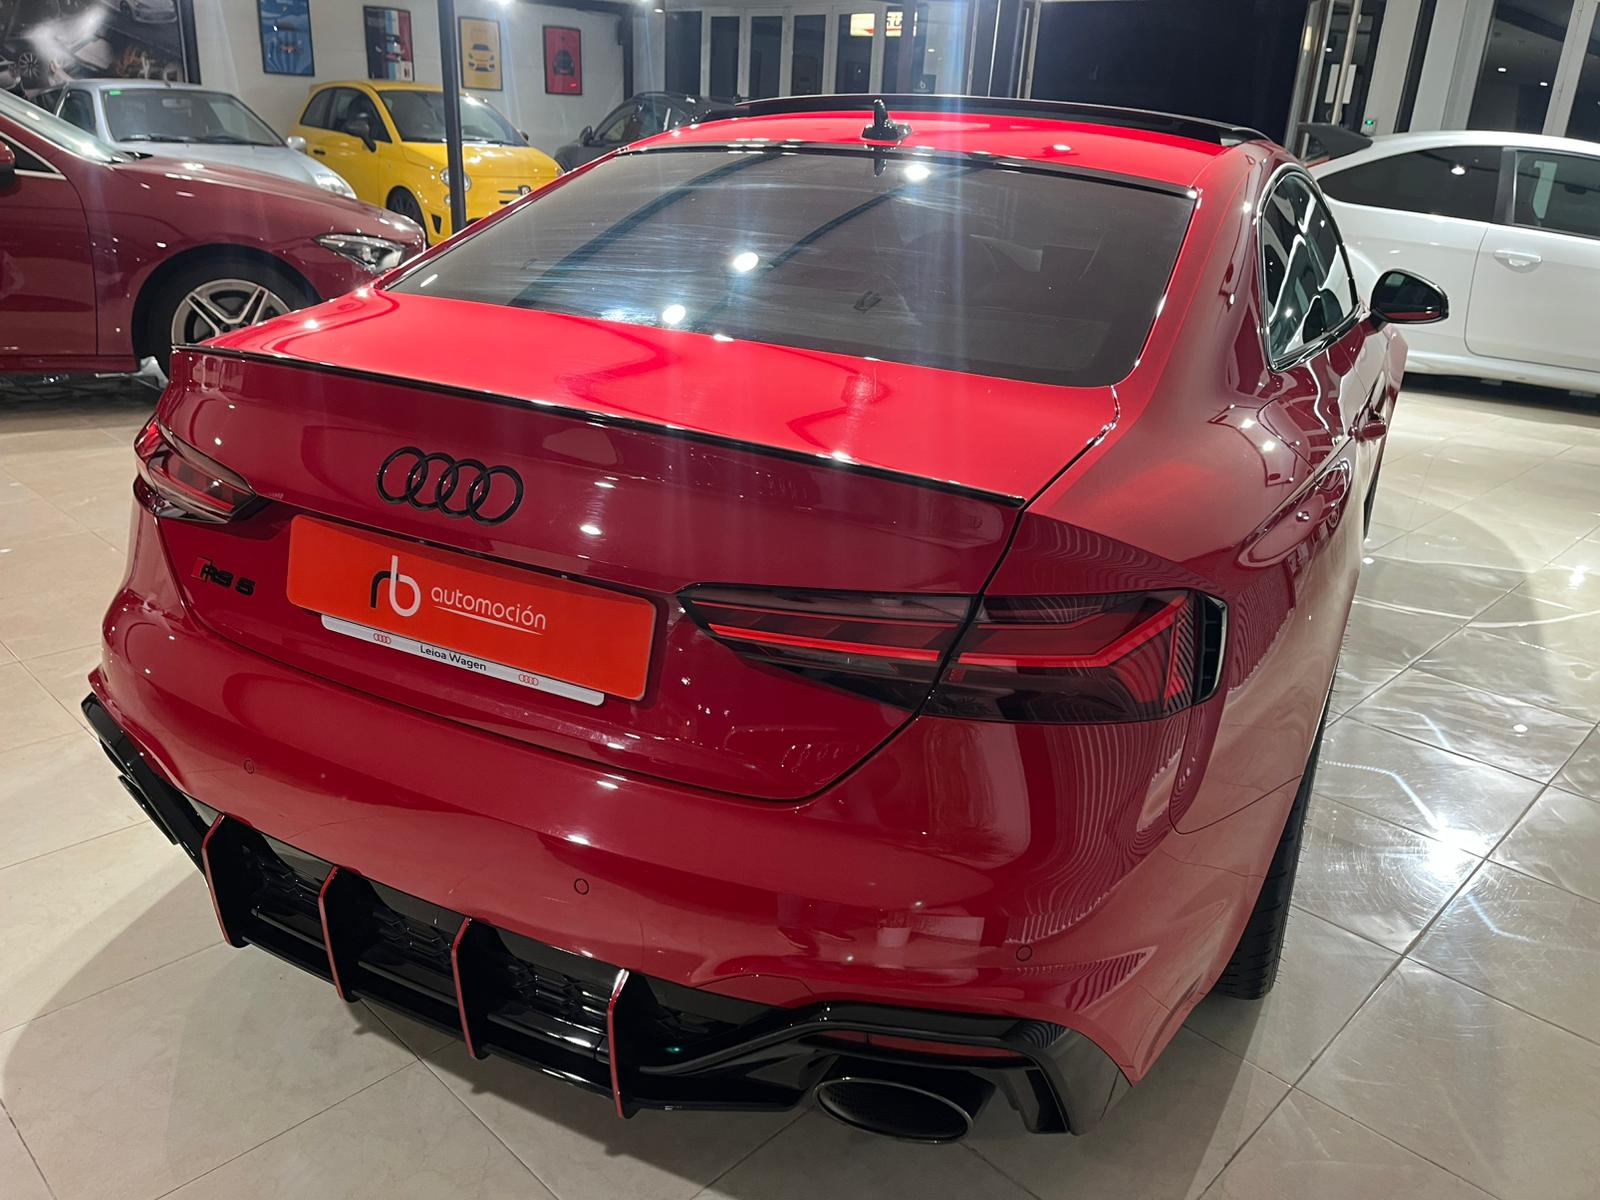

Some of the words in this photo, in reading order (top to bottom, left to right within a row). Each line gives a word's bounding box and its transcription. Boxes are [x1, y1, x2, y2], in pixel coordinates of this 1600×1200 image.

[200, 560, 234, 589] RS
[235, 577, 256, 596] 5
[370, 555, 421, 617] rb
[431, 586, 546, 630] automoción
[420, 645, 447, 660] Leioa
[449, 652, 487, 670] Wagen
